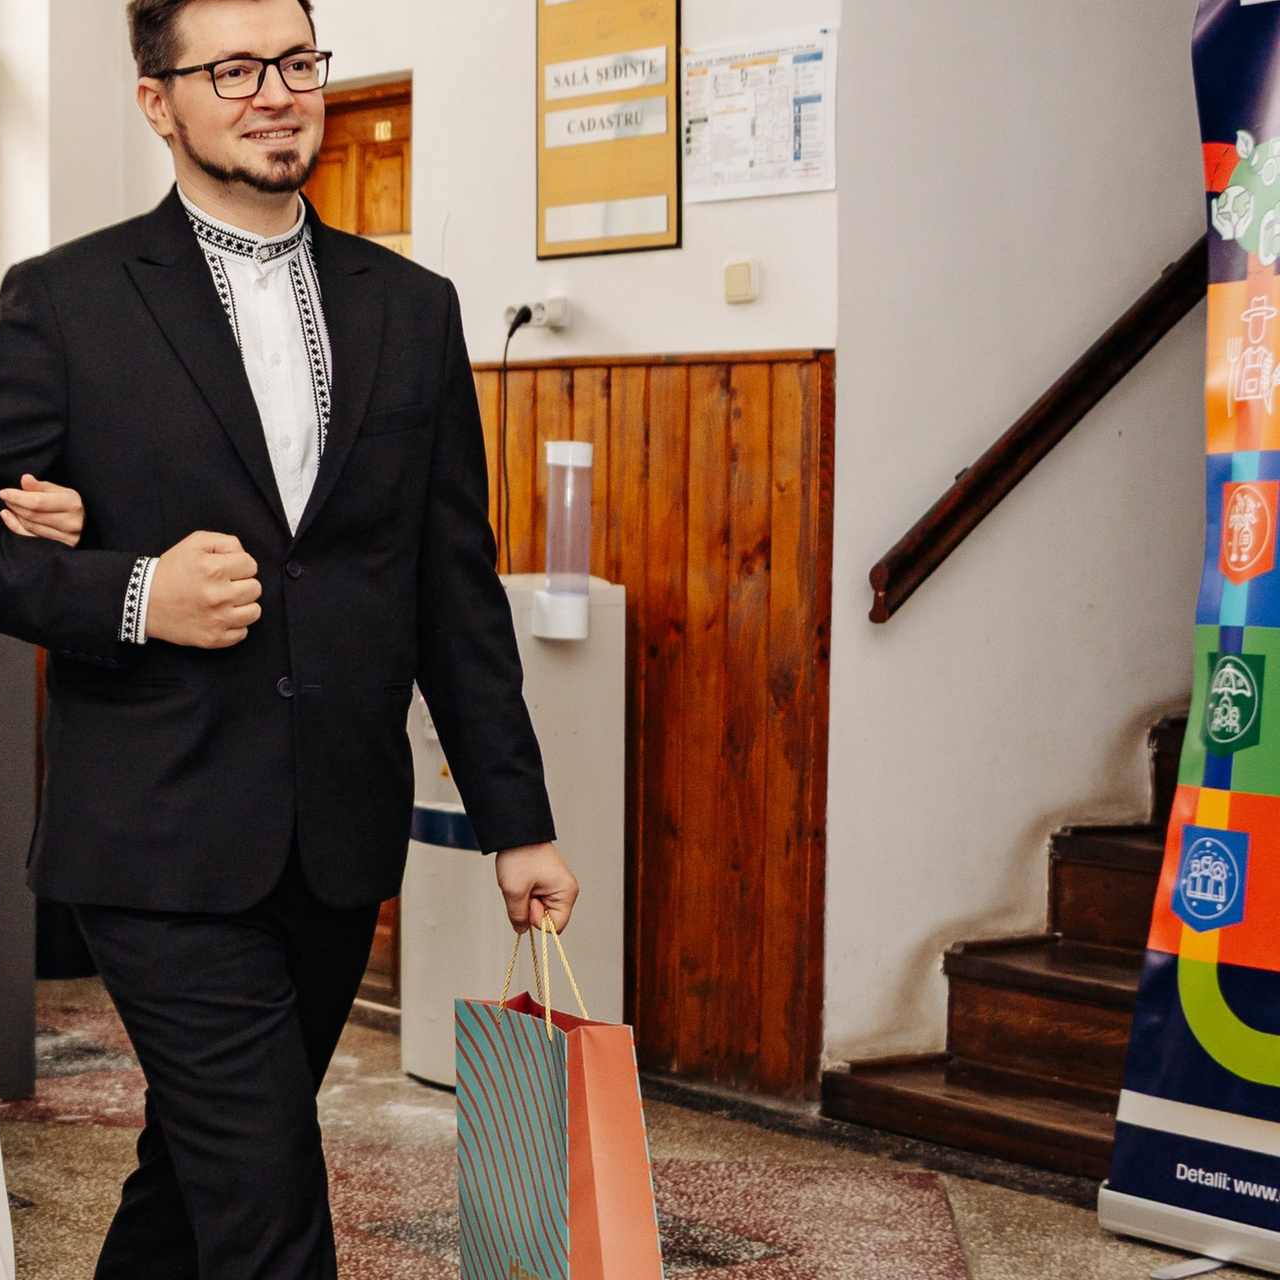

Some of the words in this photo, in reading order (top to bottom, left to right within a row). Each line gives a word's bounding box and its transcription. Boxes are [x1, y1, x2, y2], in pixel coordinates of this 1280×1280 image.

[553, 66, 589, 89] SALĂ
[567, 110, 643, 135] CADASTRU
[1176, 1163, 1231, 1191] Detalii:
[1233, 1178, 1280, 1202] www.
